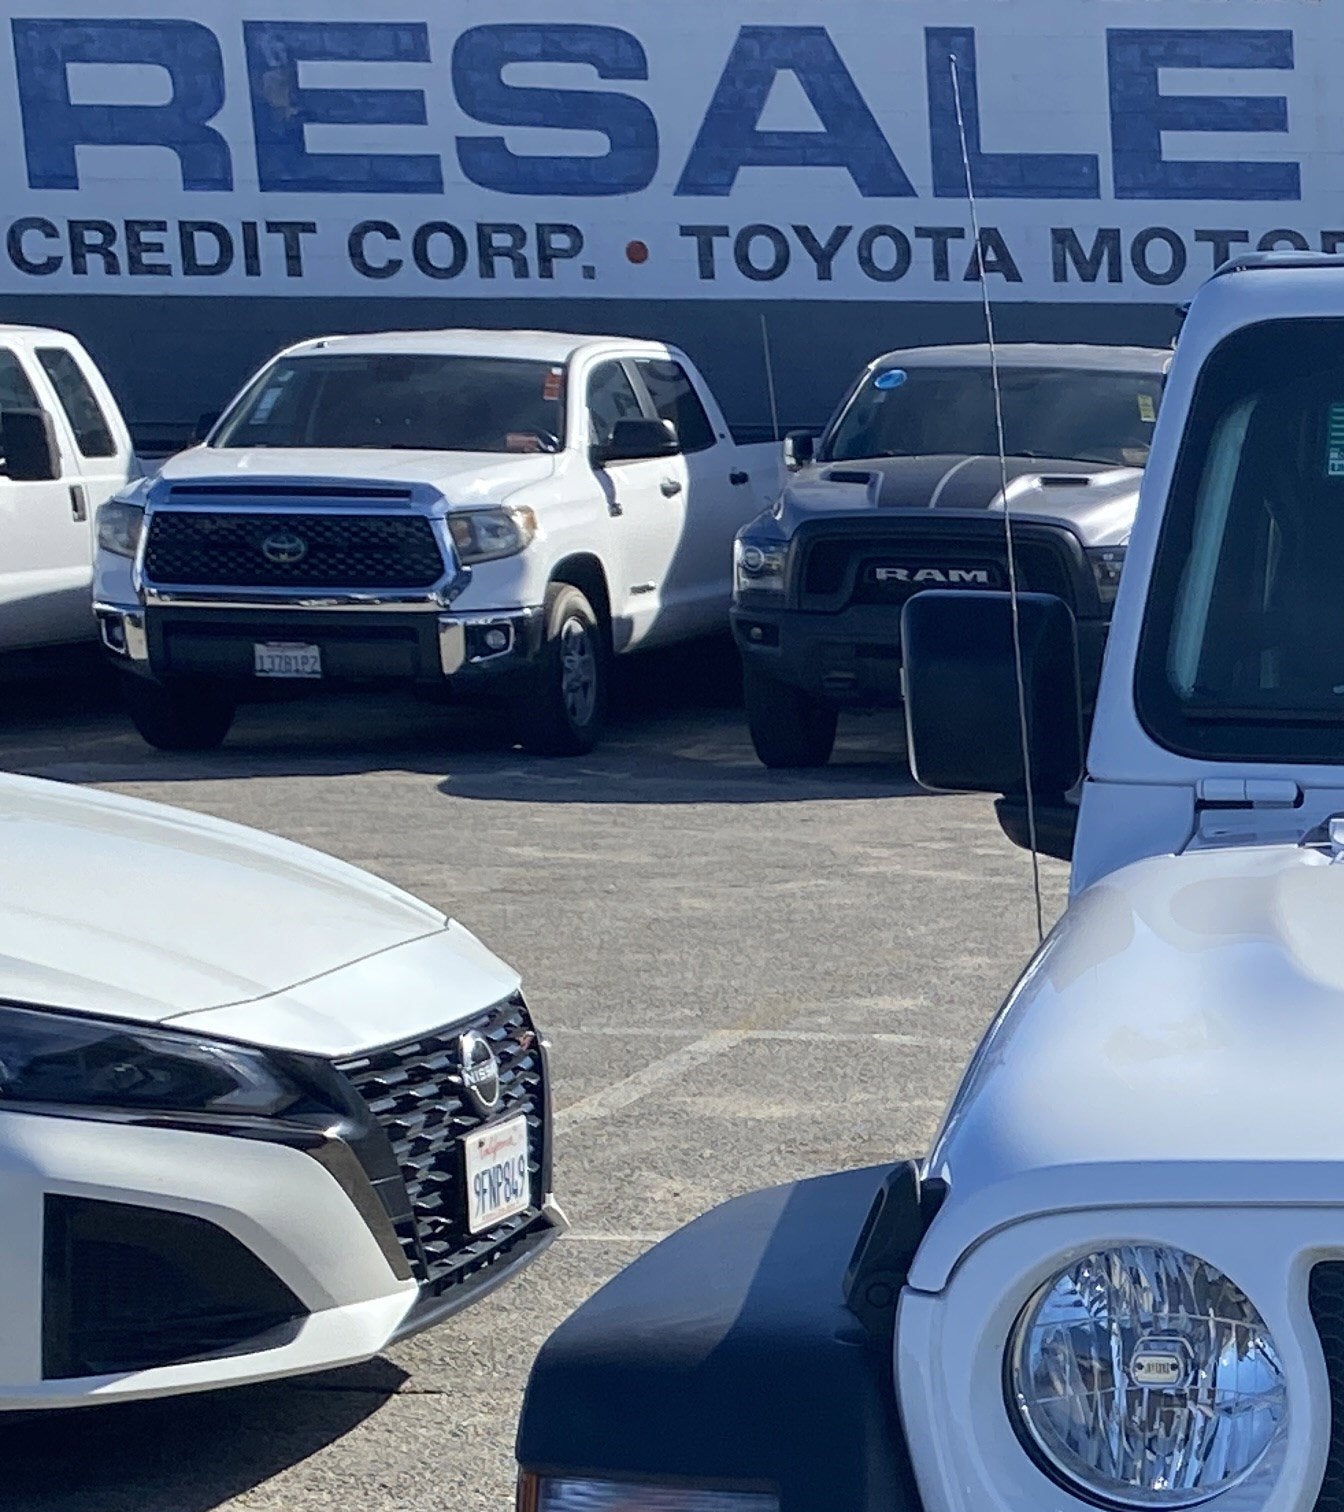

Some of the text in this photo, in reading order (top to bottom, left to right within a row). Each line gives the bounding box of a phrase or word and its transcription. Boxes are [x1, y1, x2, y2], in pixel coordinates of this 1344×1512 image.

[11, 17, 1301, 200] RESALE
[7, 217, 316, 279] CREDIT
[347, 219, 598, 281] CORP.
[679, 223, 1023, 284] TOYOTA
[875, 567, 988, 583] RAM
